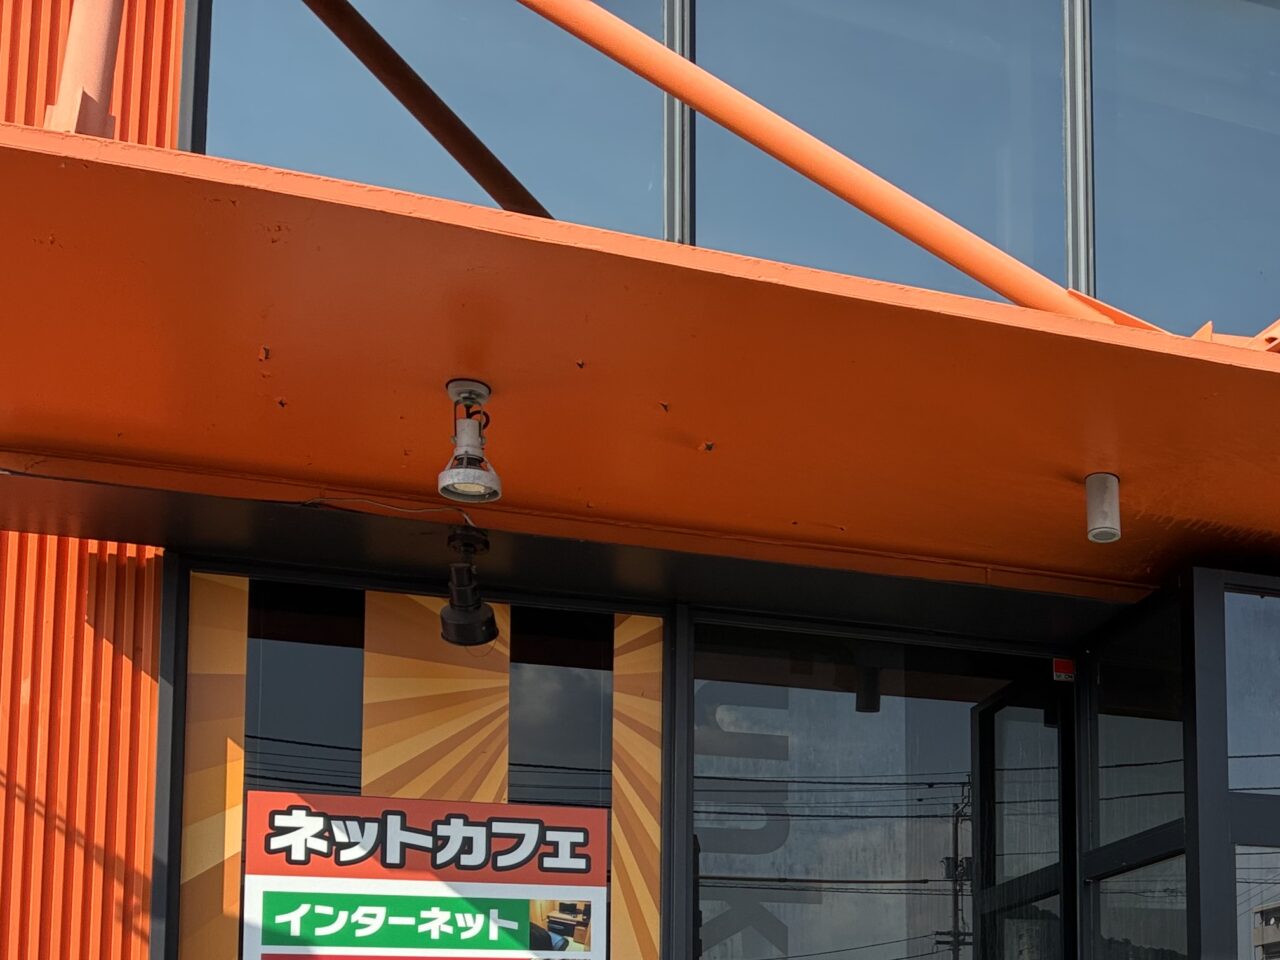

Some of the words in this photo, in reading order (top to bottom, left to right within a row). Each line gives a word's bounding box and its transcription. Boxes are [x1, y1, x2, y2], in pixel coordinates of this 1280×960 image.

[267, 806, 591, 872] ネットカフェ
[274, 903, 518, 941] インターネット
